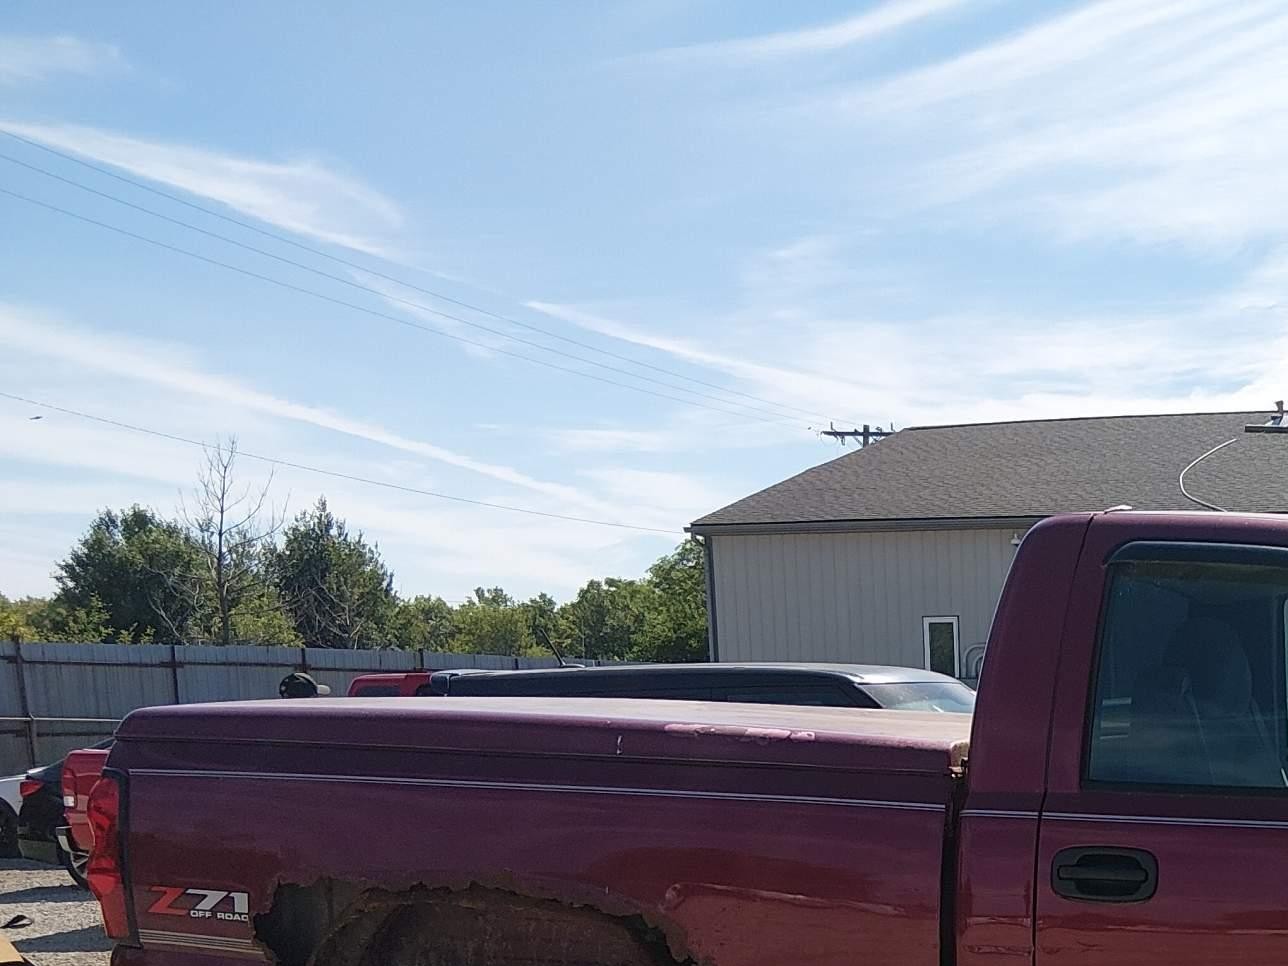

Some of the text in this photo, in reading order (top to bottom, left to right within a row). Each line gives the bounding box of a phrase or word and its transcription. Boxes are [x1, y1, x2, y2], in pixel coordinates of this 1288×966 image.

[148, 886, 249, 916] Z71
[190, 910, 249, 922] OFF ROAD
